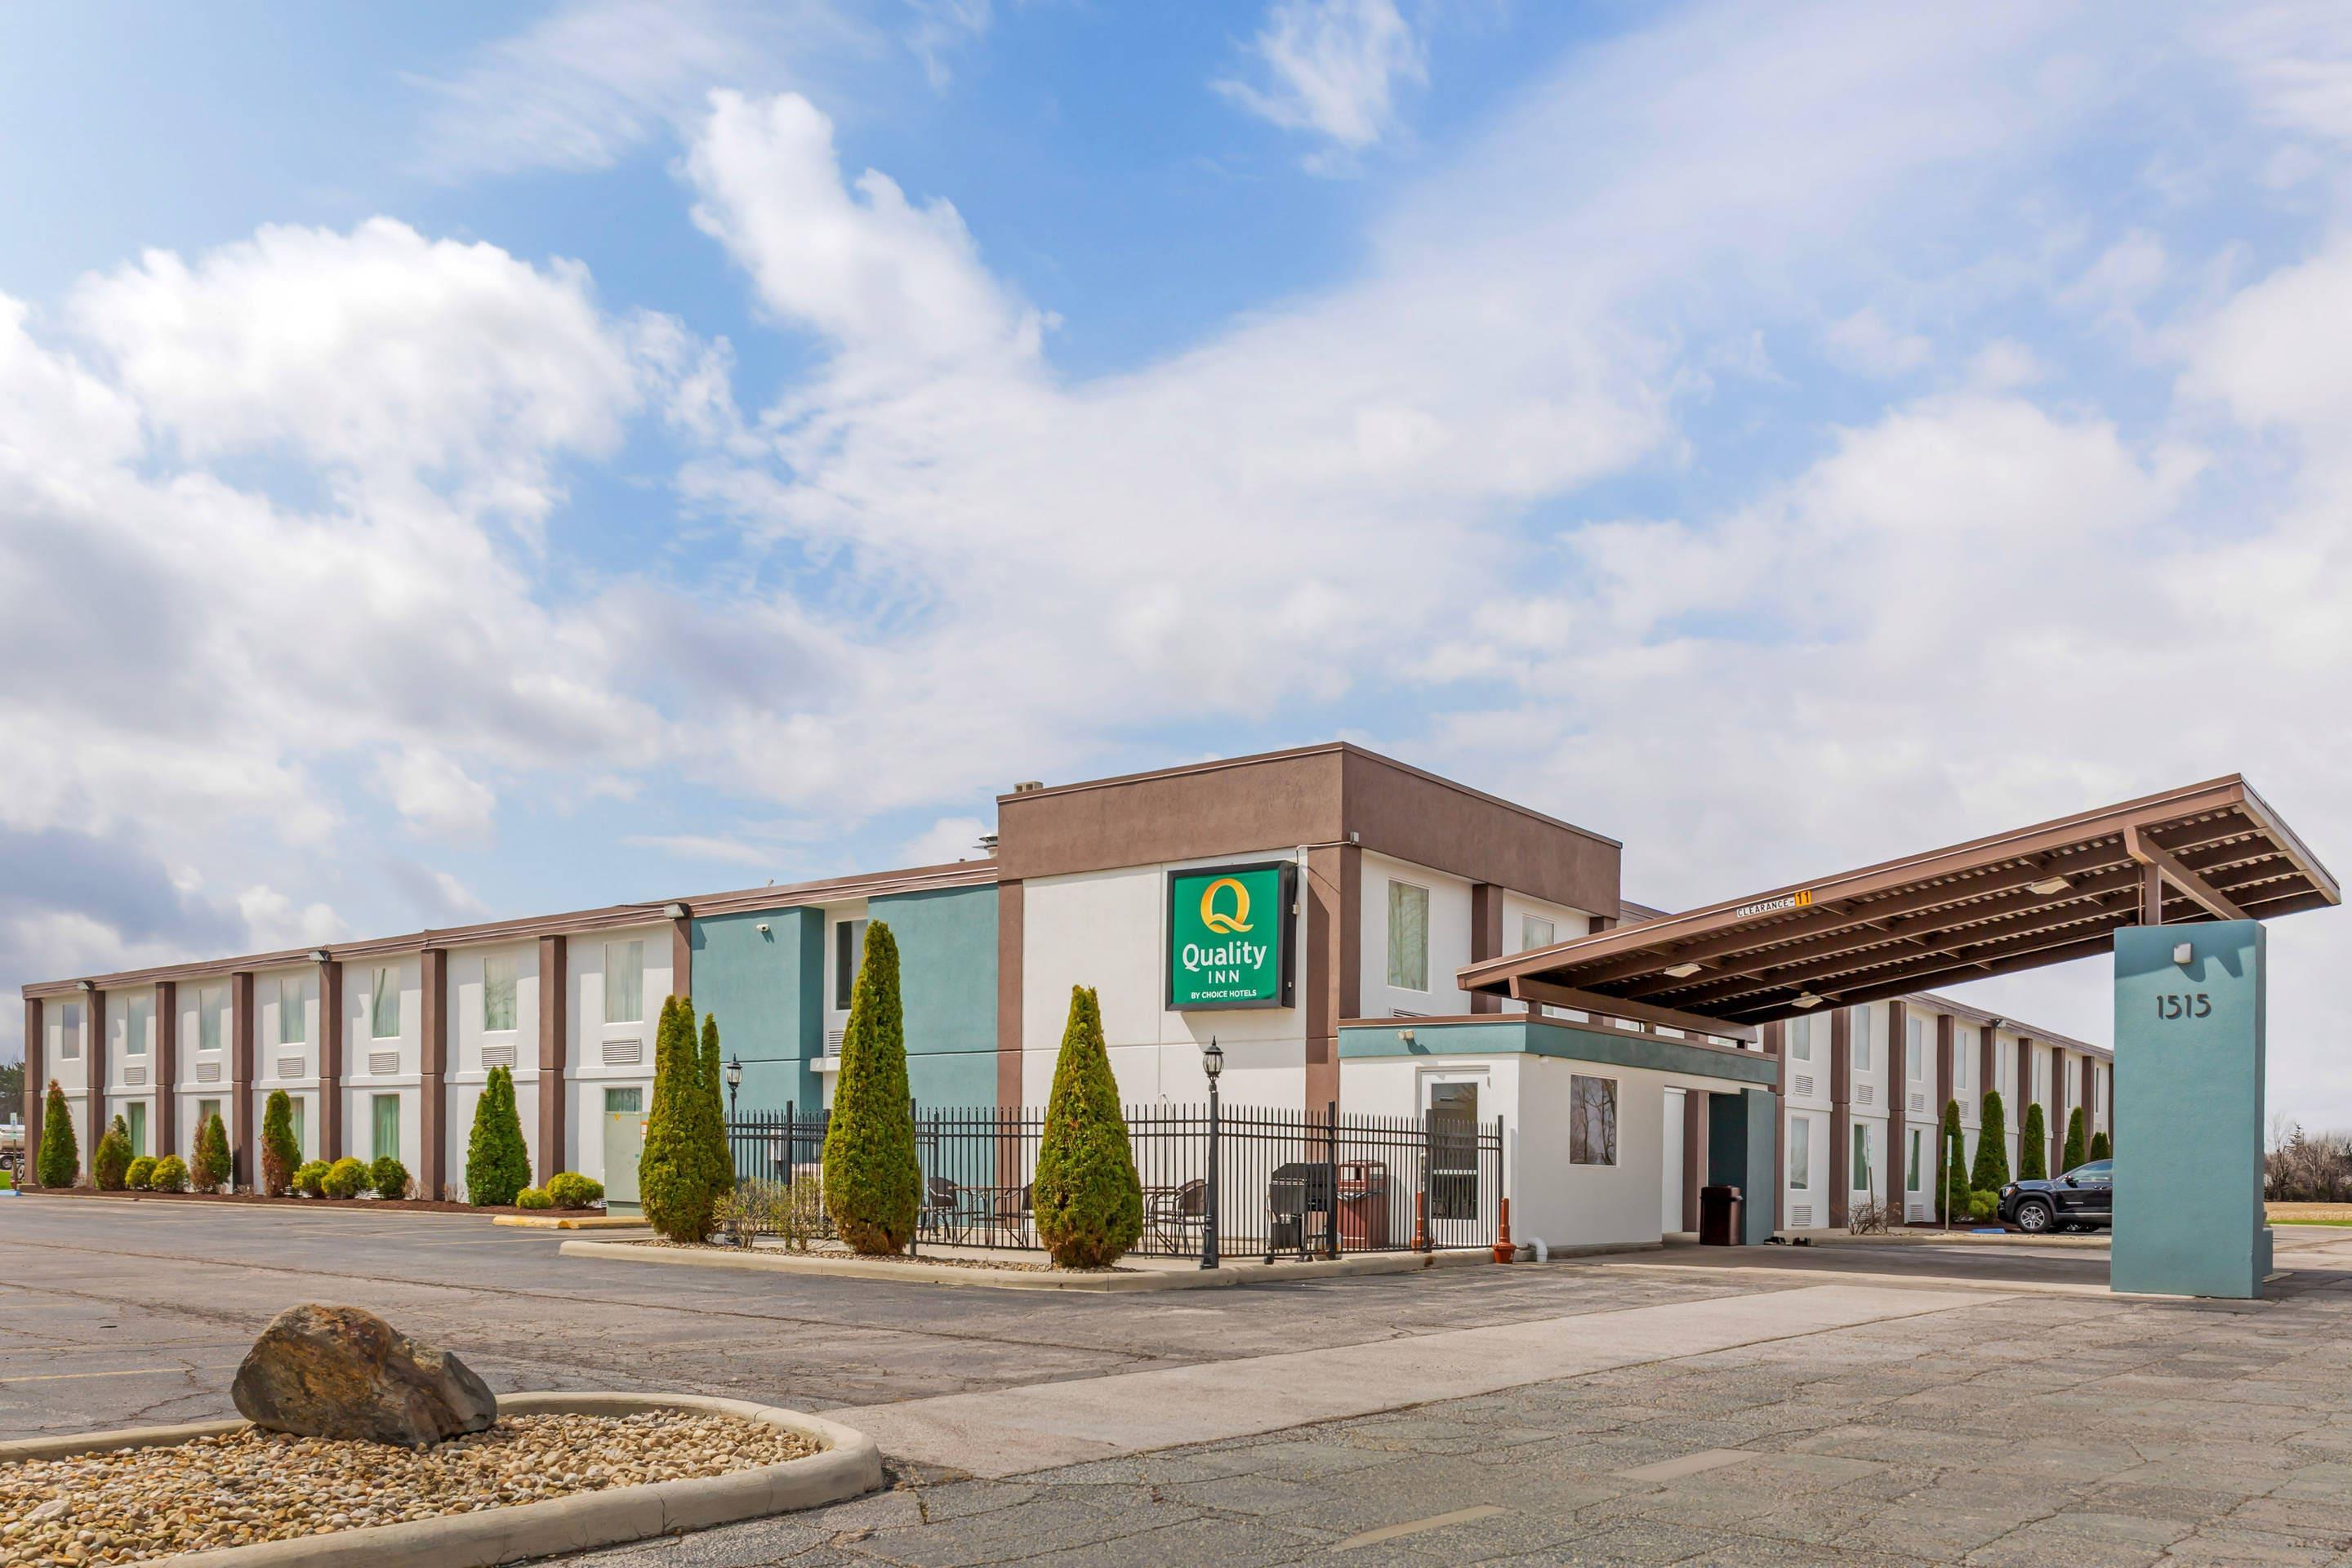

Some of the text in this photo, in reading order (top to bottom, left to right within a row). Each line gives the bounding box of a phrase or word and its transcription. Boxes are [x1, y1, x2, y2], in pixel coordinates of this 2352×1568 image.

[1200, 878, 1254, 934] Q
[1183, 941, 1267, 972] Quality
[1208, 969, 1240, 984] INN
[1201, 990, 1227, 999] CHOICE
[1229, 989, 1257, 997] HOTELS
[2157, 993, 2212, 1019] 1515
